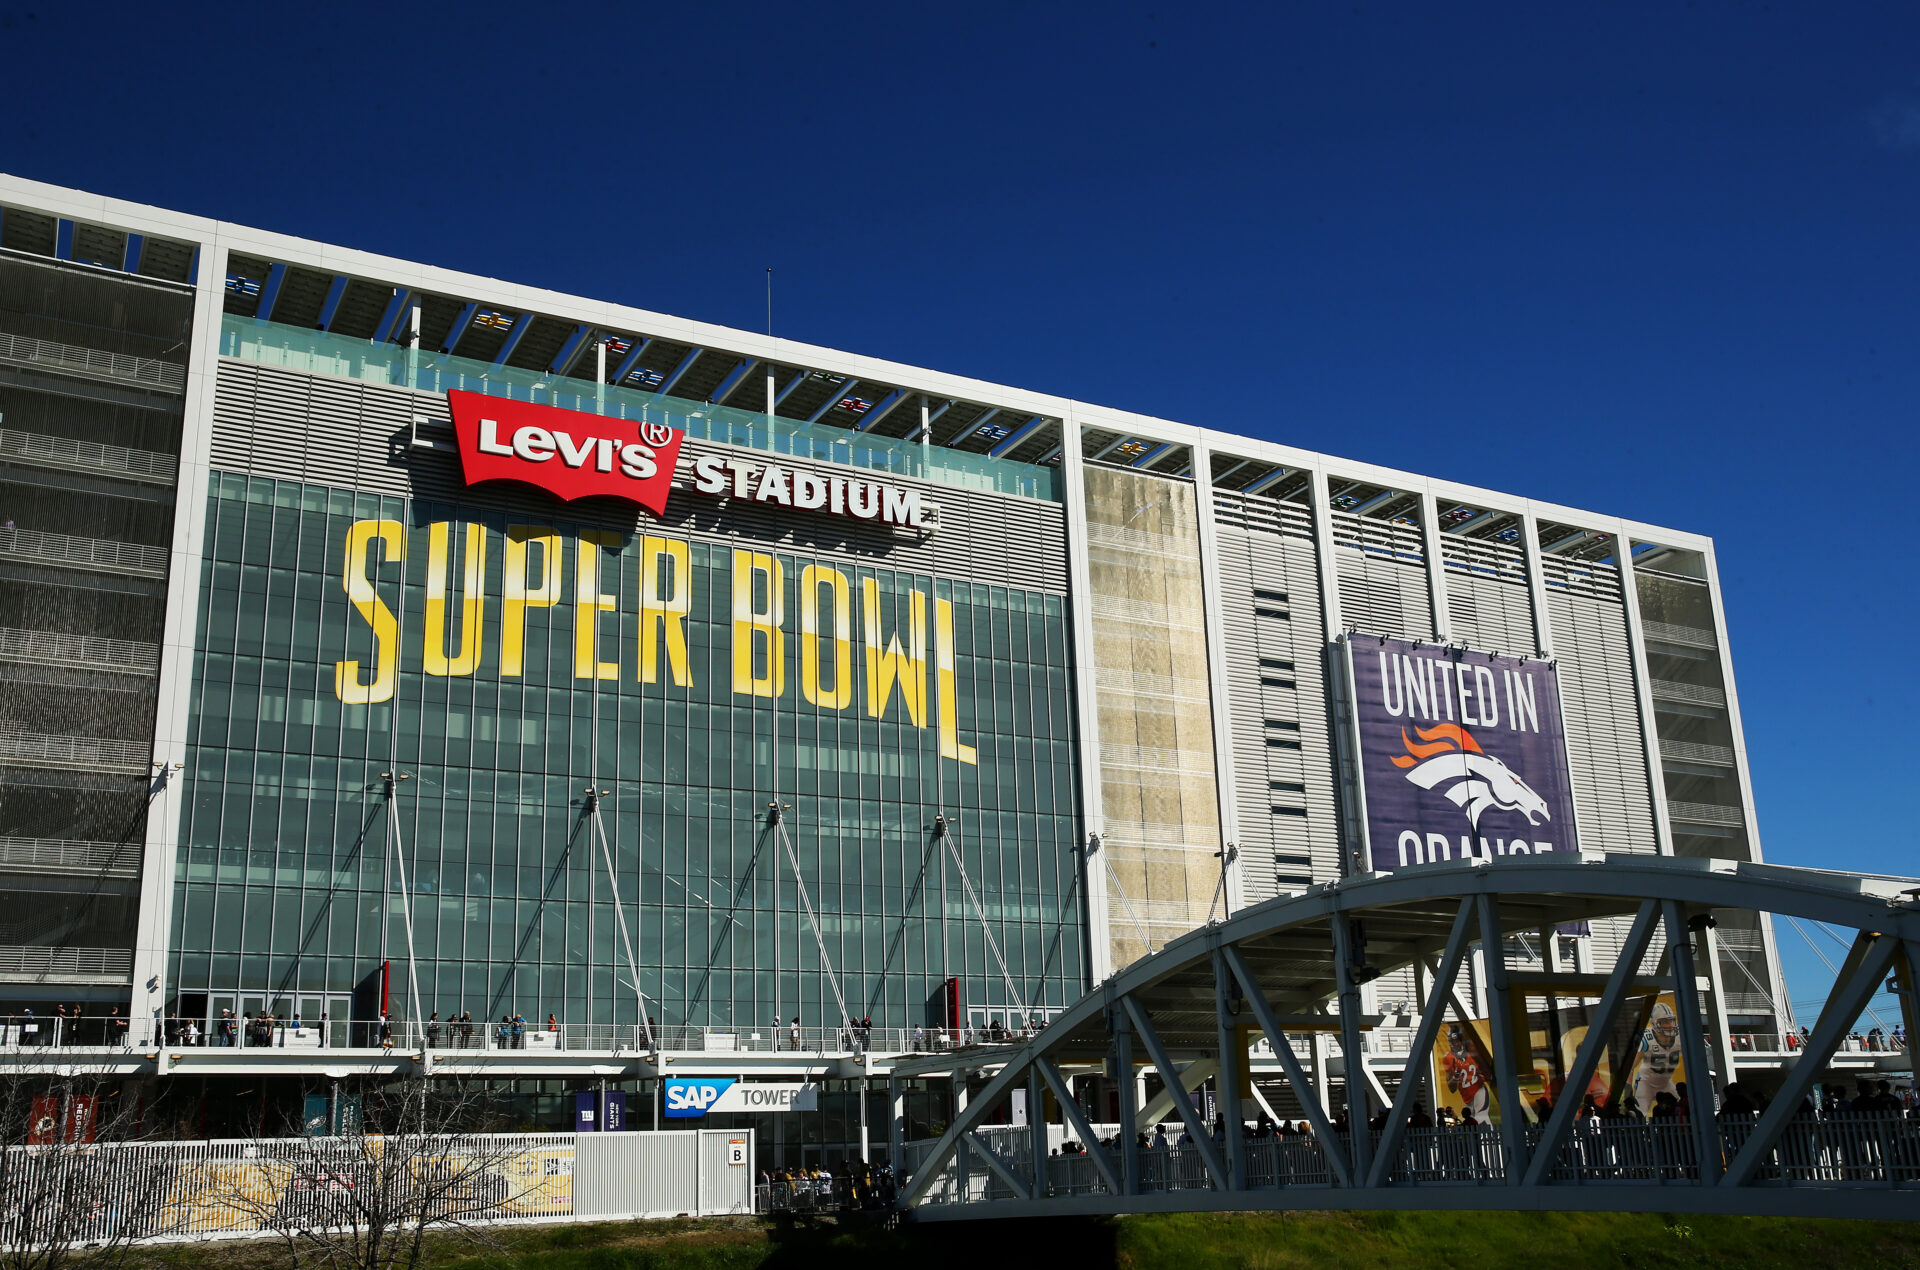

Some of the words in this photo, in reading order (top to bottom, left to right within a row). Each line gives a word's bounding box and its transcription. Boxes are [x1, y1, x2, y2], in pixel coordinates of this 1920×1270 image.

[692, 455, 923, 528] STADIUM
[334, 519, 694, 706] SUPER
[732, 548, 979, 767] BOWL
[1379, 651, 1499, 728] UNITED
[1504, 668, 1541, 734] IN
[667, 1085, 719, 1110] SAP
[741, 1089, 801, 1106] TOWER
[1460, 1063, 1479, 1089] 22
[733, 1149, 742, 1161] B
